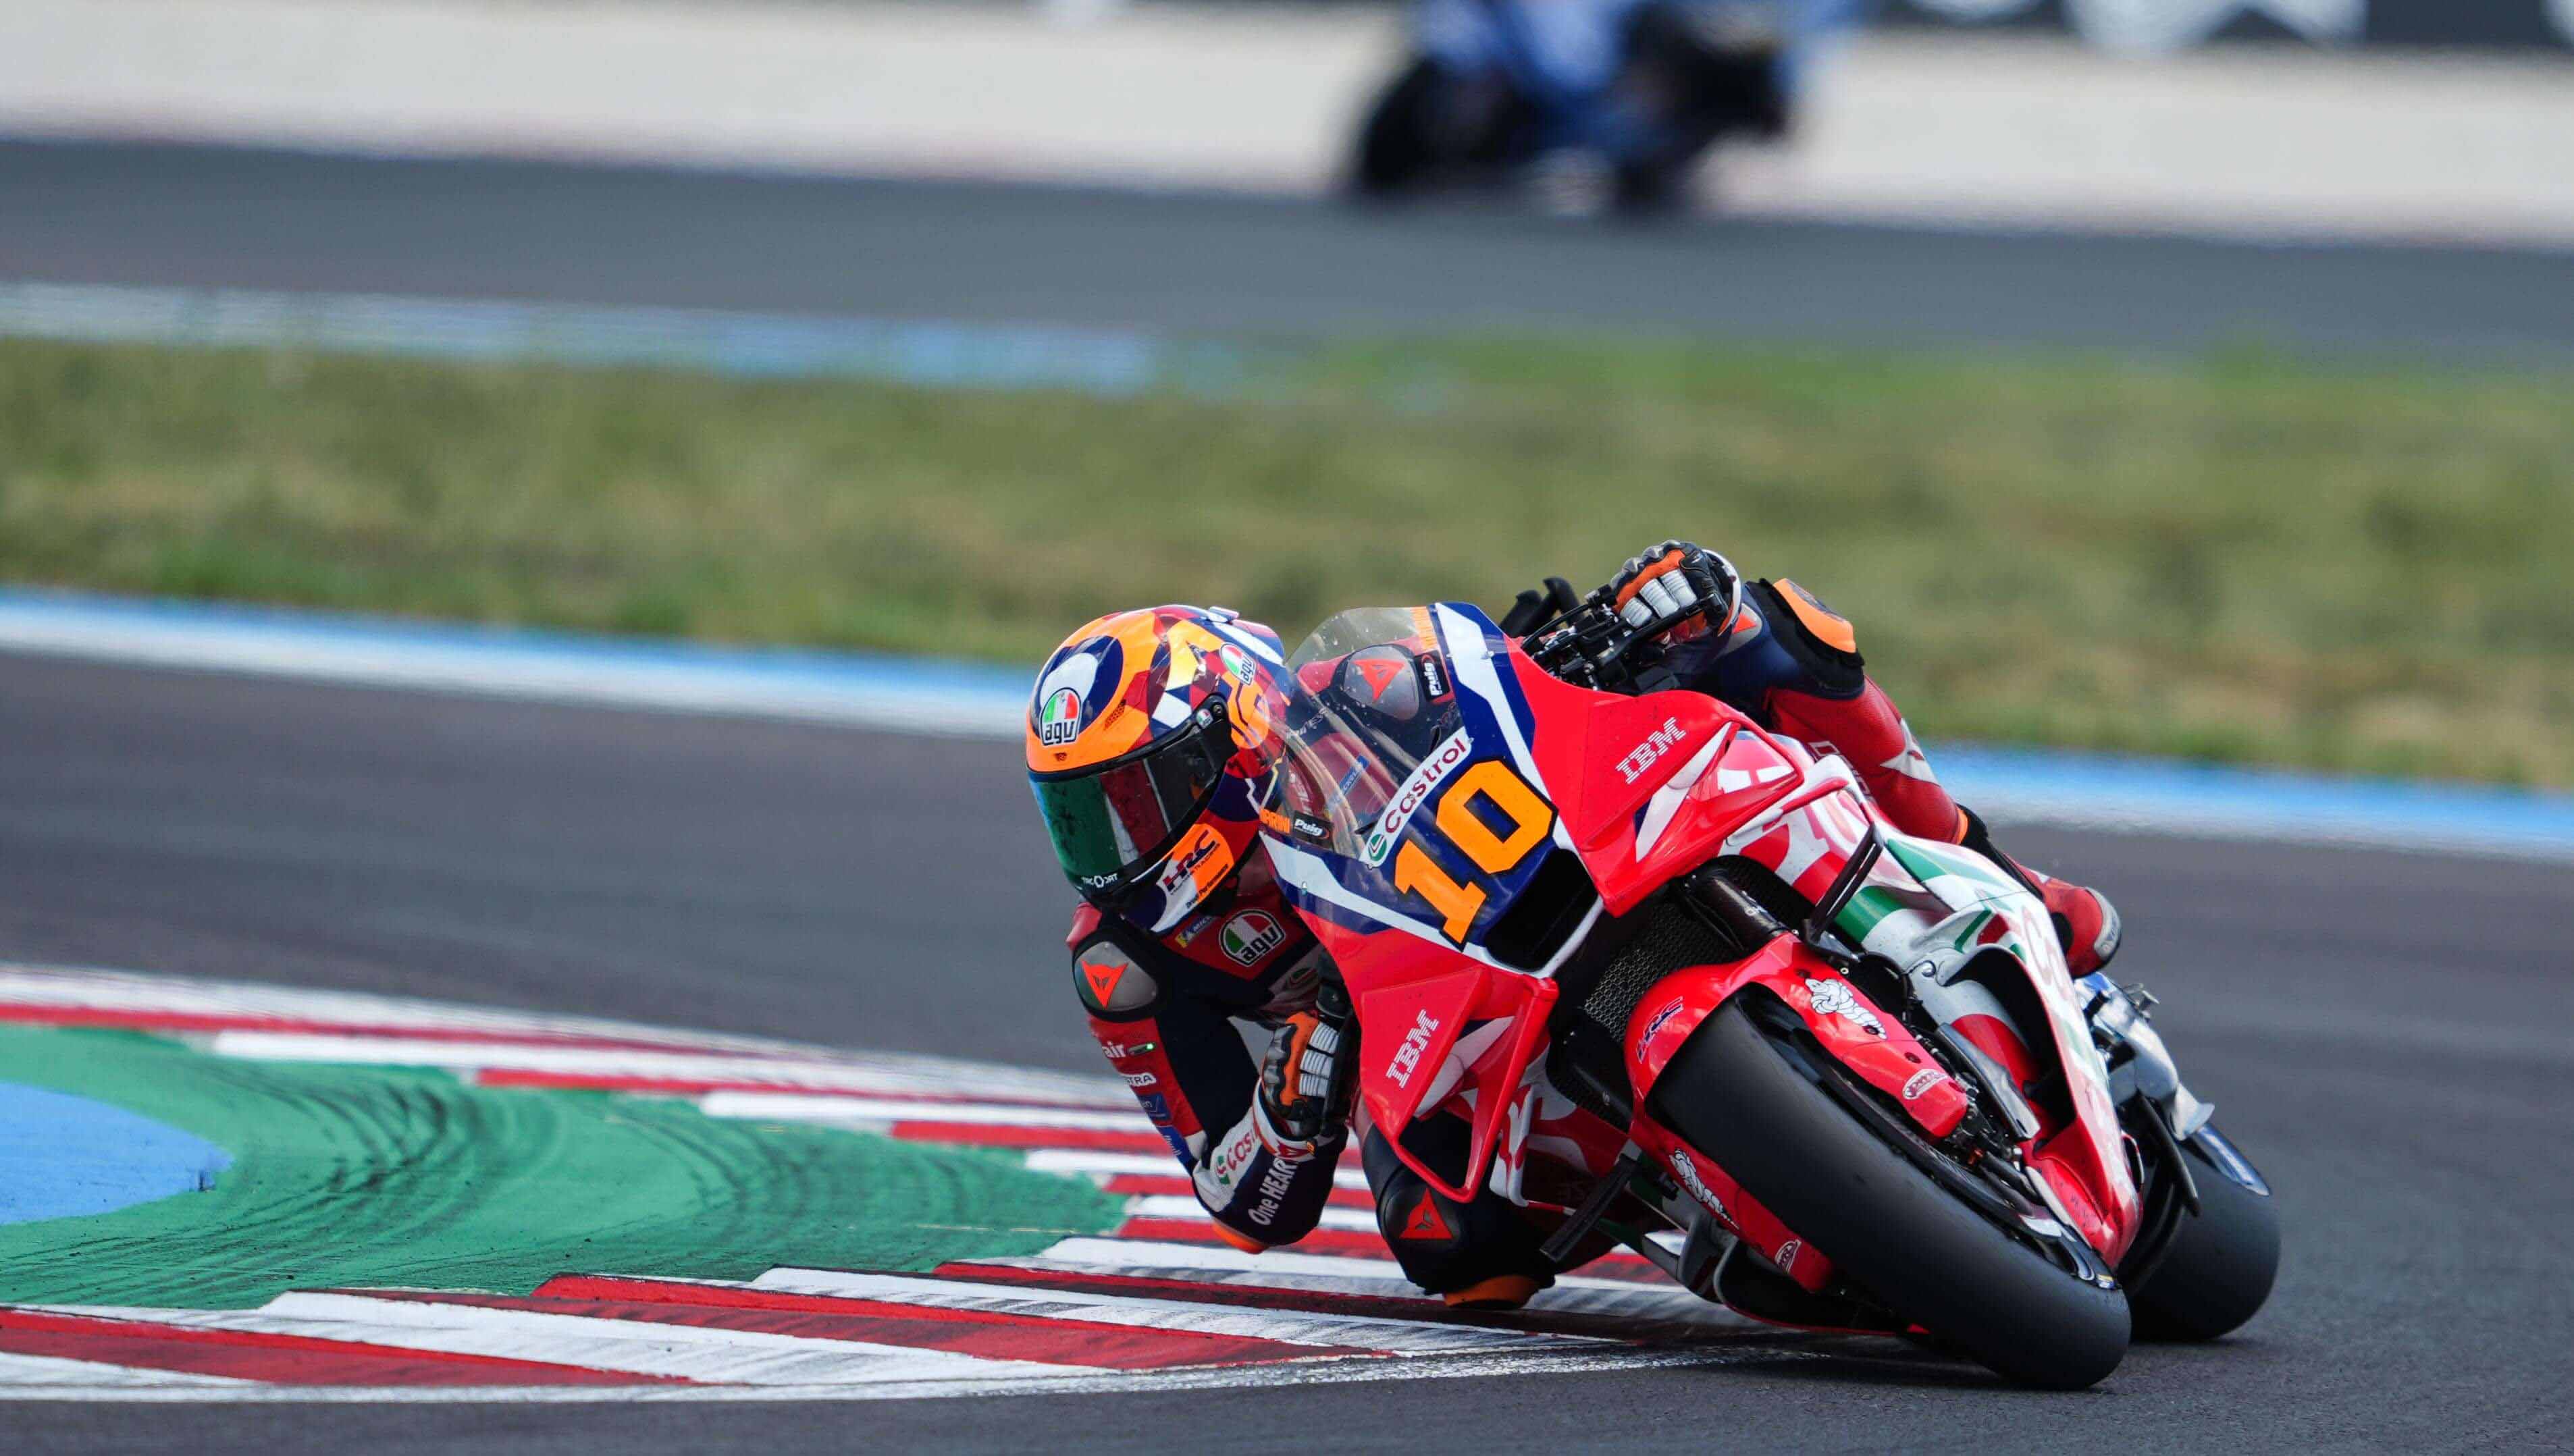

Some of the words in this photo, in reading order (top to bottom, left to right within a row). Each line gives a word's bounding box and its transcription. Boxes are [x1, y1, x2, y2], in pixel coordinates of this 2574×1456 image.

[1240, 656, 1255, 682] agv
[1045, 721, 1075, 744] agv
[1615, 717, 1686, 784] IBM
[1385, 738, 1467, 833] Castrol
[1294, 818, 1323, 836] Puig
[1394, 759, 1553, 945] 10
[1163, 830, 1215, 891] HRC
[1240, 926, 1279, 961] agv
[1386, 1009, 1439, 1088] IBM
[1635, 996, 1684, 1064] HRC
[1259, 1157, 1298, 1201] HEAR
[1248, 1198, 1279, 1226] One
